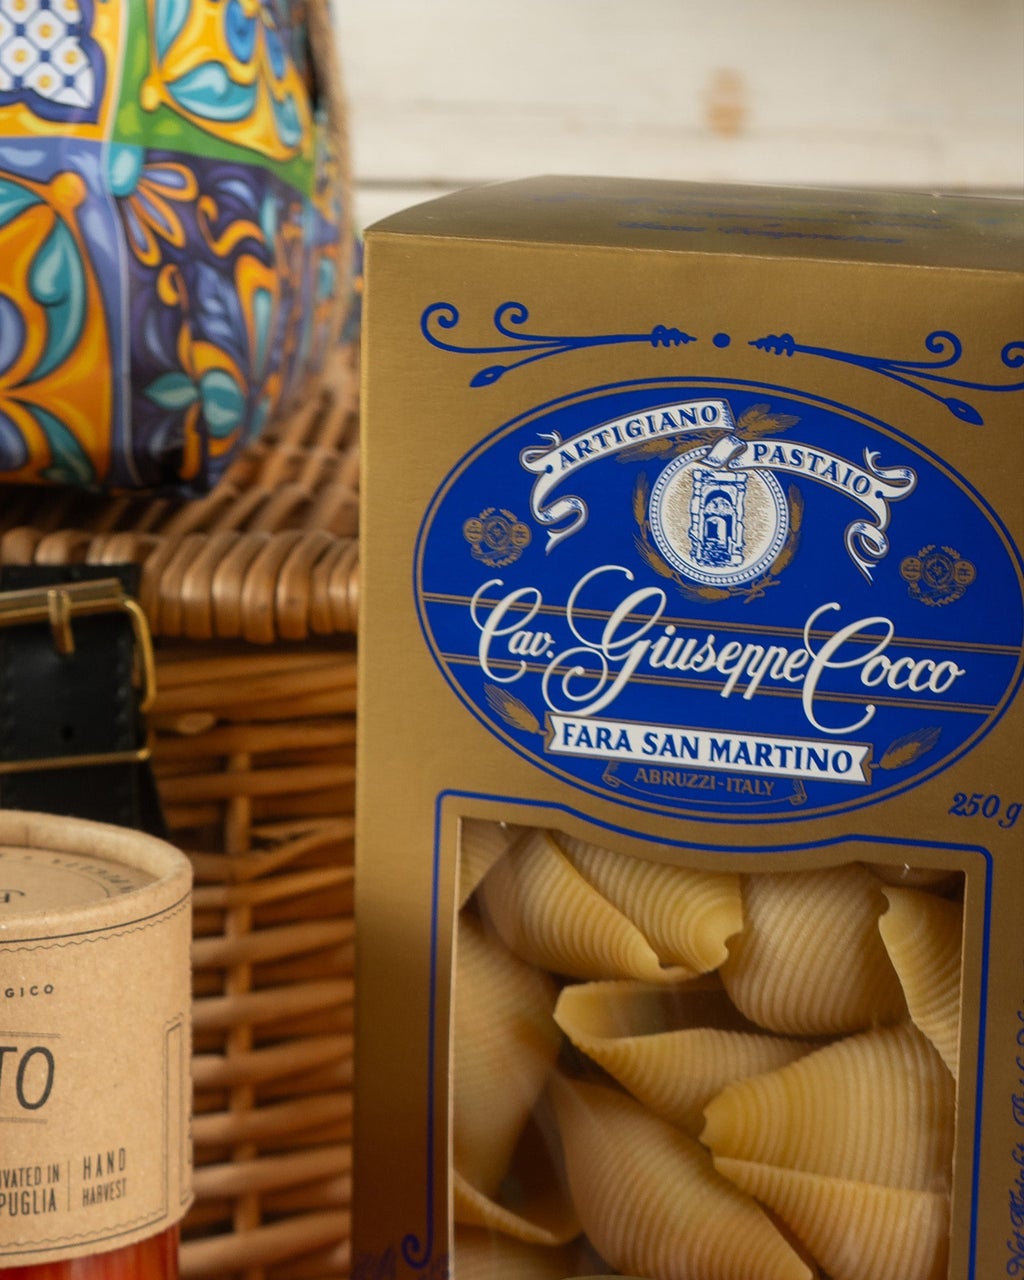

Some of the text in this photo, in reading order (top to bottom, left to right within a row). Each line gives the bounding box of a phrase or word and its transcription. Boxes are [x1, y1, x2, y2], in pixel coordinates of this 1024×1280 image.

[557, 402, 718, 470] ARTIGIANO
[752, 443, 872, 496] PASTAIO
[471, 565, 966, 734] Cav. Giuseppe Cocco
[562, 722, 853, 776] FARA SAN MARTINO
[633, 766, 776, 797] ABRUZZI-ITALY
[949, 791, 1023, 830] 250 g
[47, 1163, 61, 1184] IN
[82, 1147, 127, 1181] HAND
[82, 1177, 128, 1208] HARVEST
